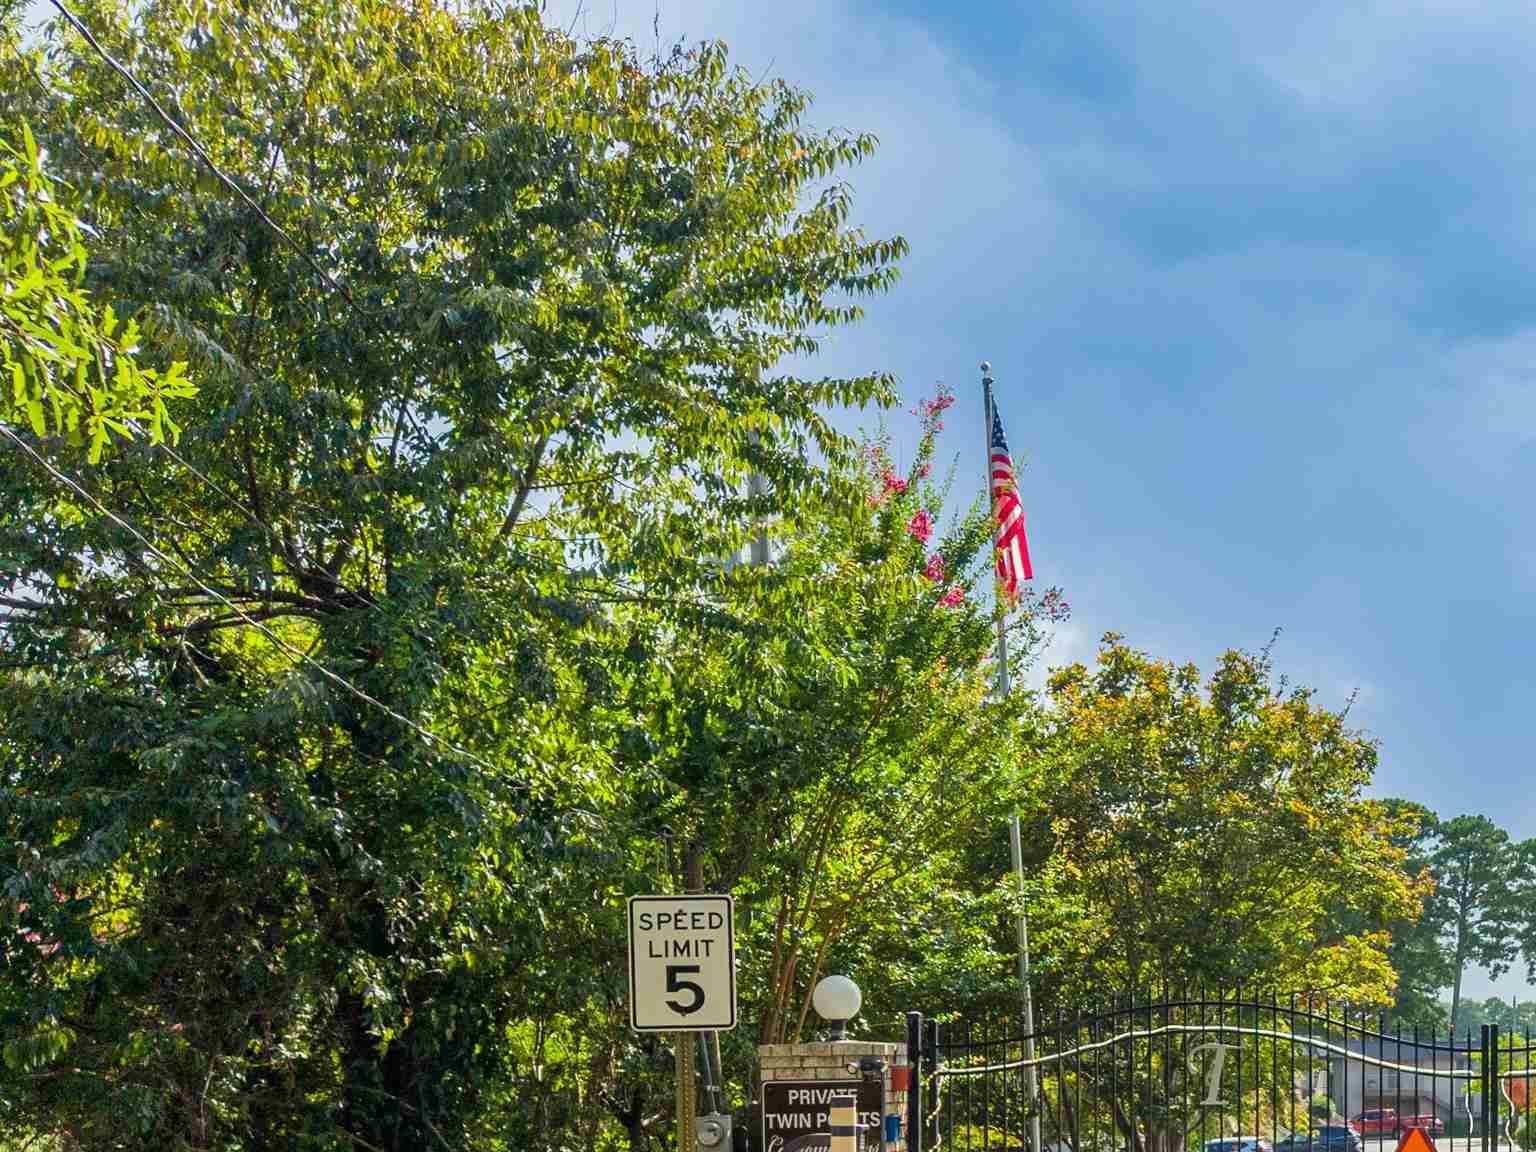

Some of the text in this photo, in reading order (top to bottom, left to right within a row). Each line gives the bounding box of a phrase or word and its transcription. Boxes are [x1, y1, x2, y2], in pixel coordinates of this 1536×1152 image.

[639, 911, 723, 931] SPEED
[648, 939, 714, 959] LIMIT
[665, 965, 705, 1015] 5
[765, 1112, 881, 1129] TWIN PTS
